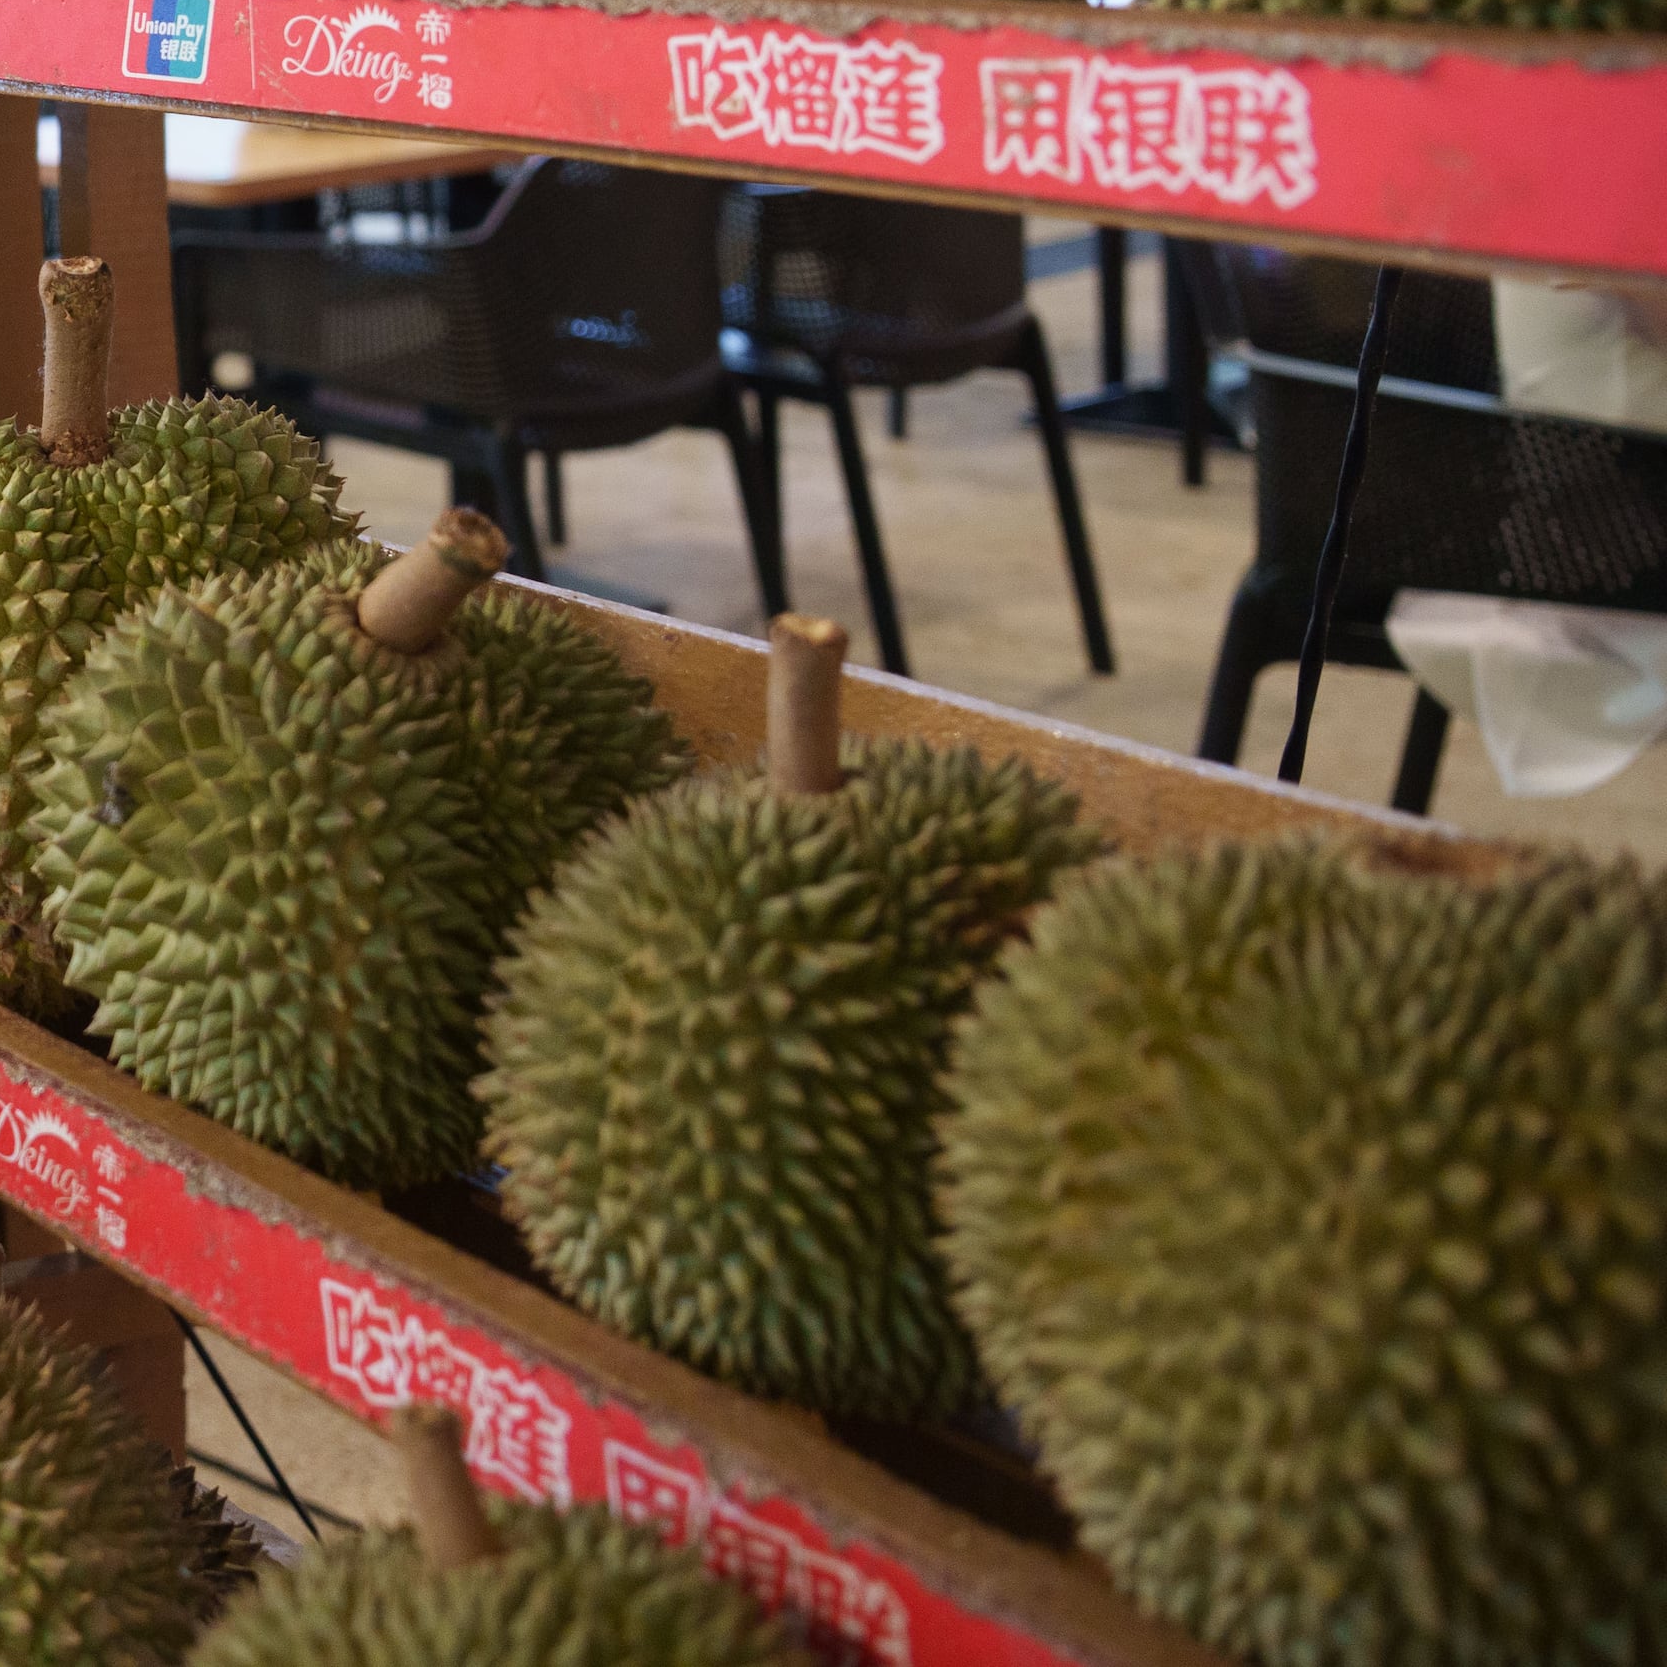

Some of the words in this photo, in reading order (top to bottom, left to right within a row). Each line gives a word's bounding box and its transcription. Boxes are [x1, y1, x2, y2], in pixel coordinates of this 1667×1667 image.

[133, 12, 205, 47] UnionPay
[160, 38, 198, 62] 银联
[415, 7, 454, 110] 帝一榴
[978, 53, 1320, 210] 用银联
